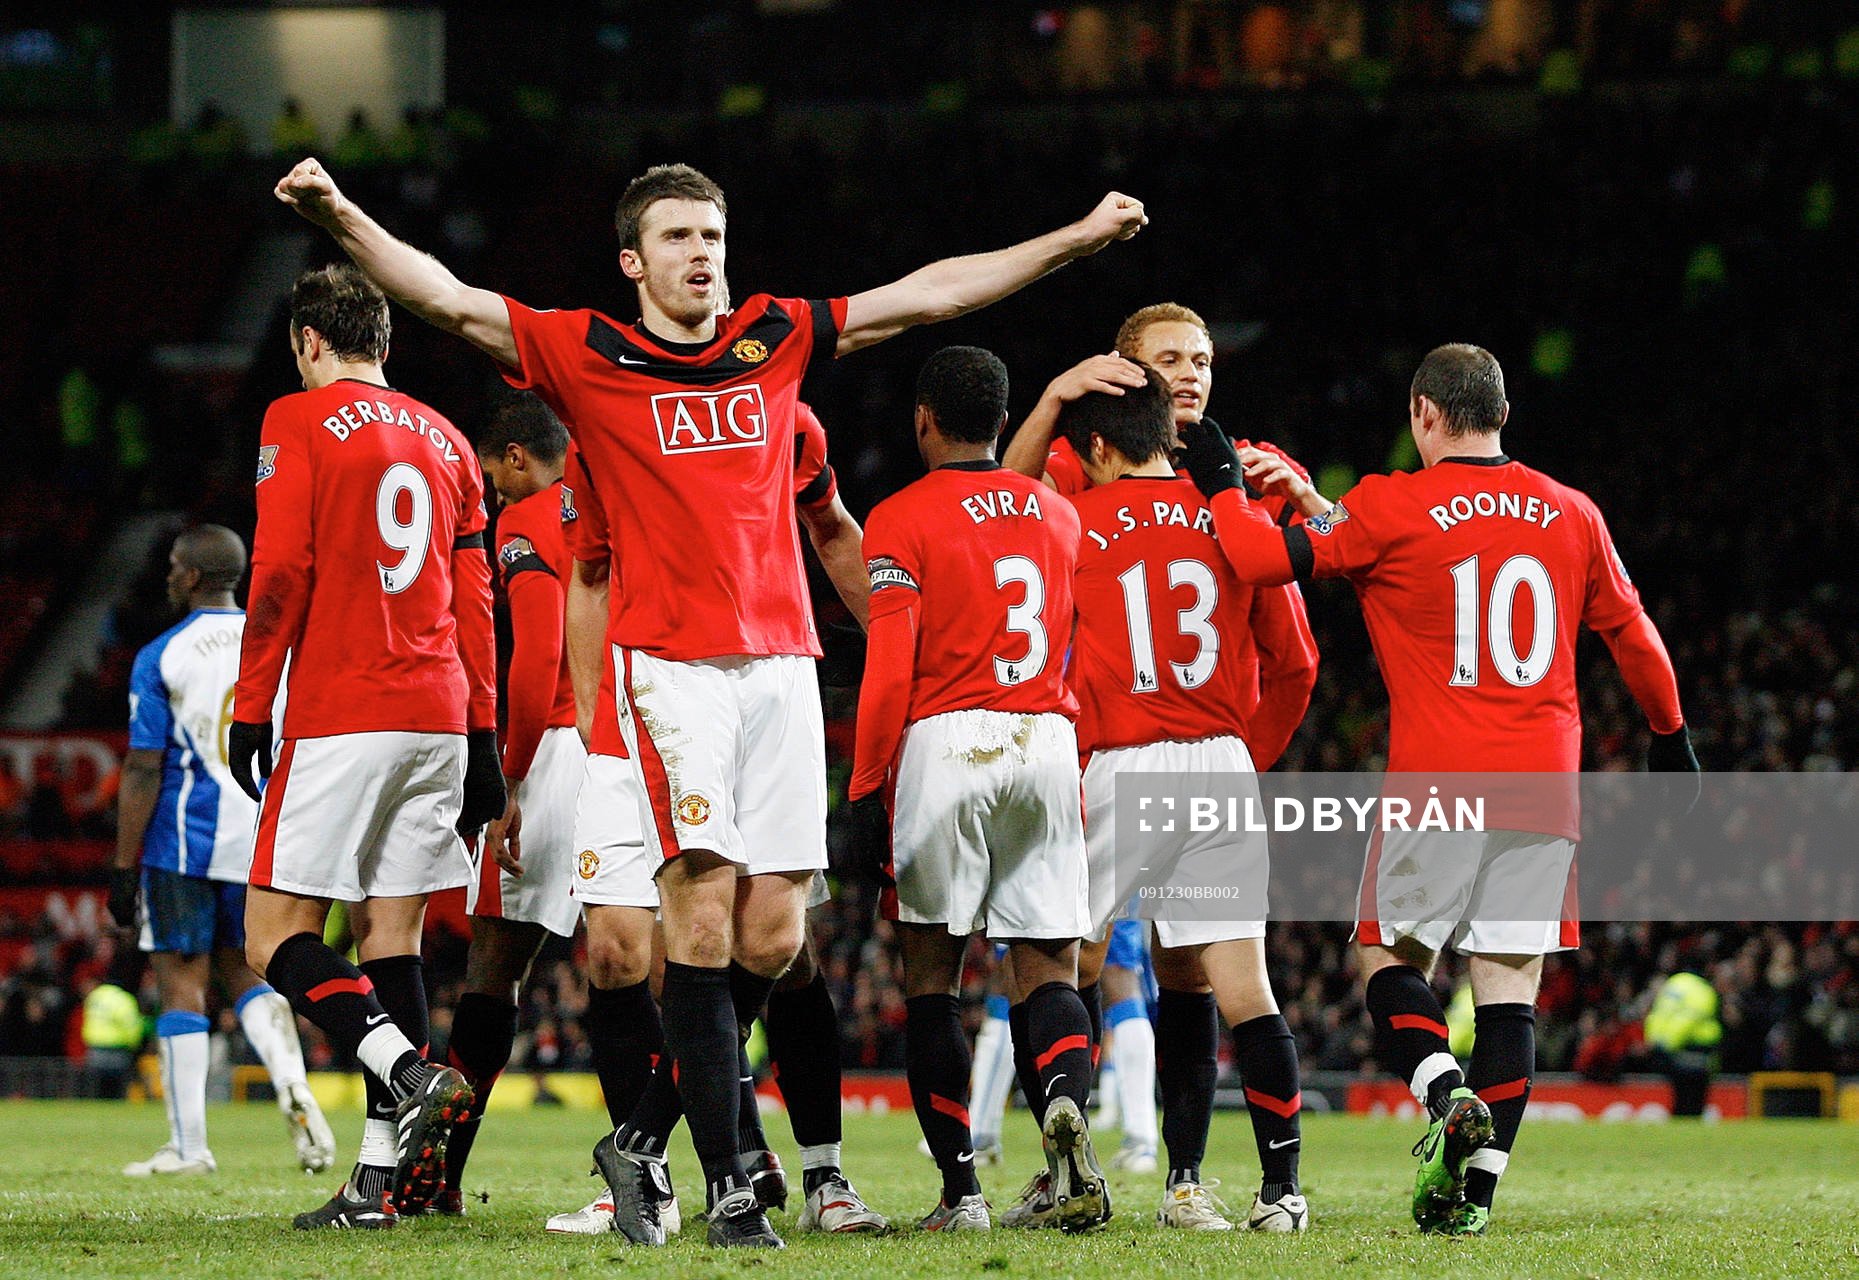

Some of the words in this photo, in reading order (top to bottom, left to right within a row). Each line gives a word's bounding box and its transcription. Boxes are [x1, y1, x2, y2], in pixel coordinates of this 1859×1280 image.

[322, 400, 461, 463] BERBATOV
[668, 392, 761, 446] AIG
[376, 462, 433, 594] 9
[960, 490, 1043, 524] EVRA
[1087, 501, 1219, 550] J.S.PAR
[1428, 491, 1561, 532] ROONEY
[993, 554, 1049, 687] 3
[1117, 558, 1221, 694] 13
[1449, 554, 1557, 688] 10
